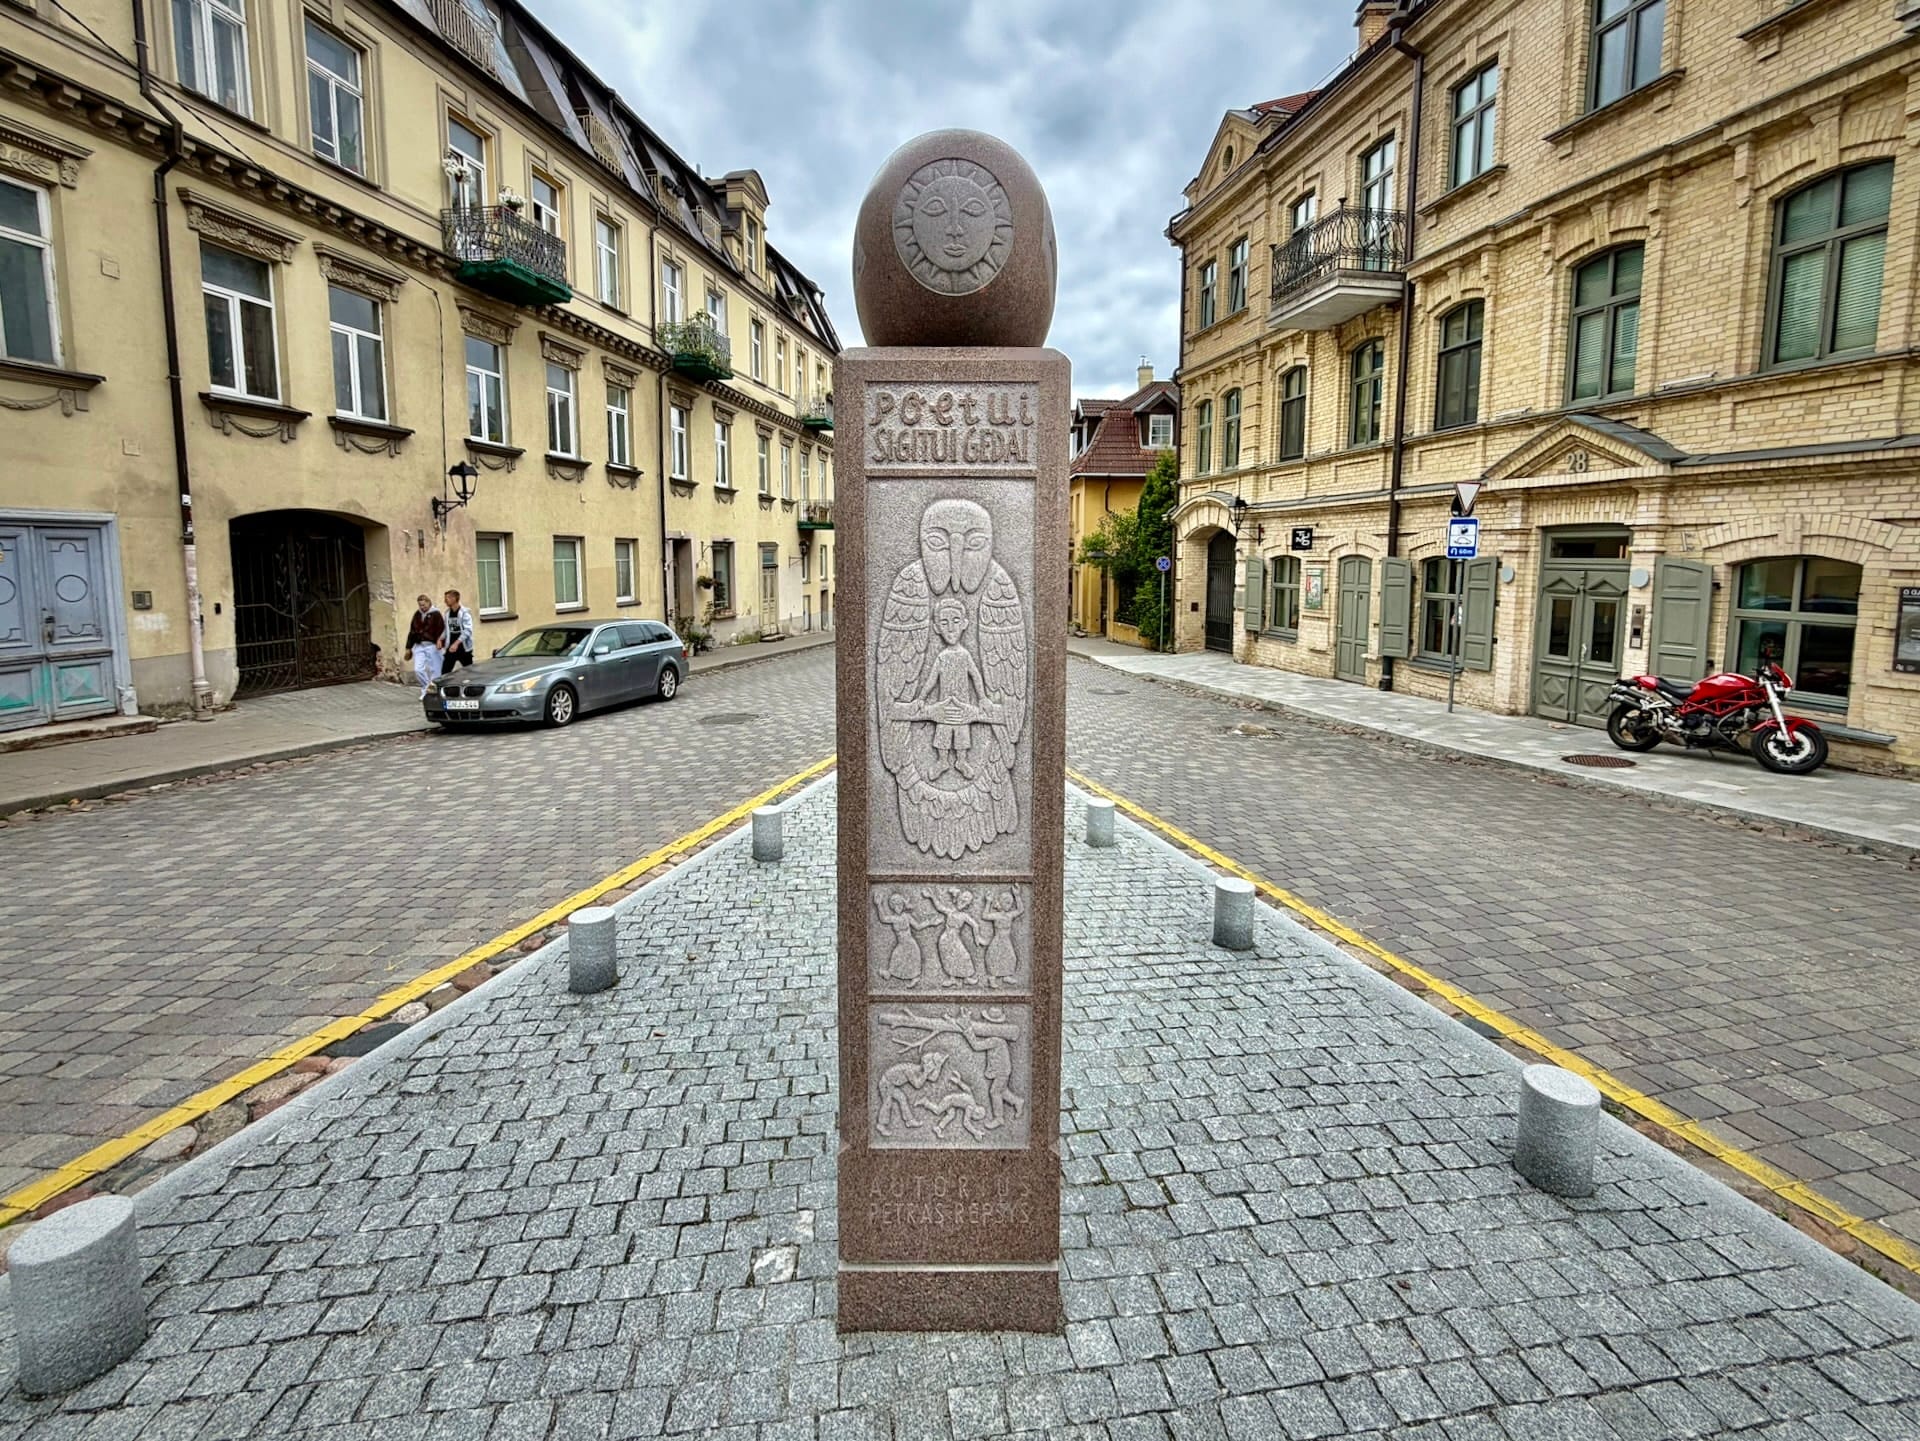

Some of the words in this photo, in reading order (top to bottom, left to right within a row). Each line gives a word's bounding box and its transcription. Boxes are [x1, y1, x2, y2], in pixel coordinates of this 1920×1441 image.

[963, 427, 1029, 463] GEDAI
[1567, 450, 1587, 473] 28
[869, 1176, 1032, 1198] AUTORIUS
[869, 1202, 945, 1224] PETRAS
